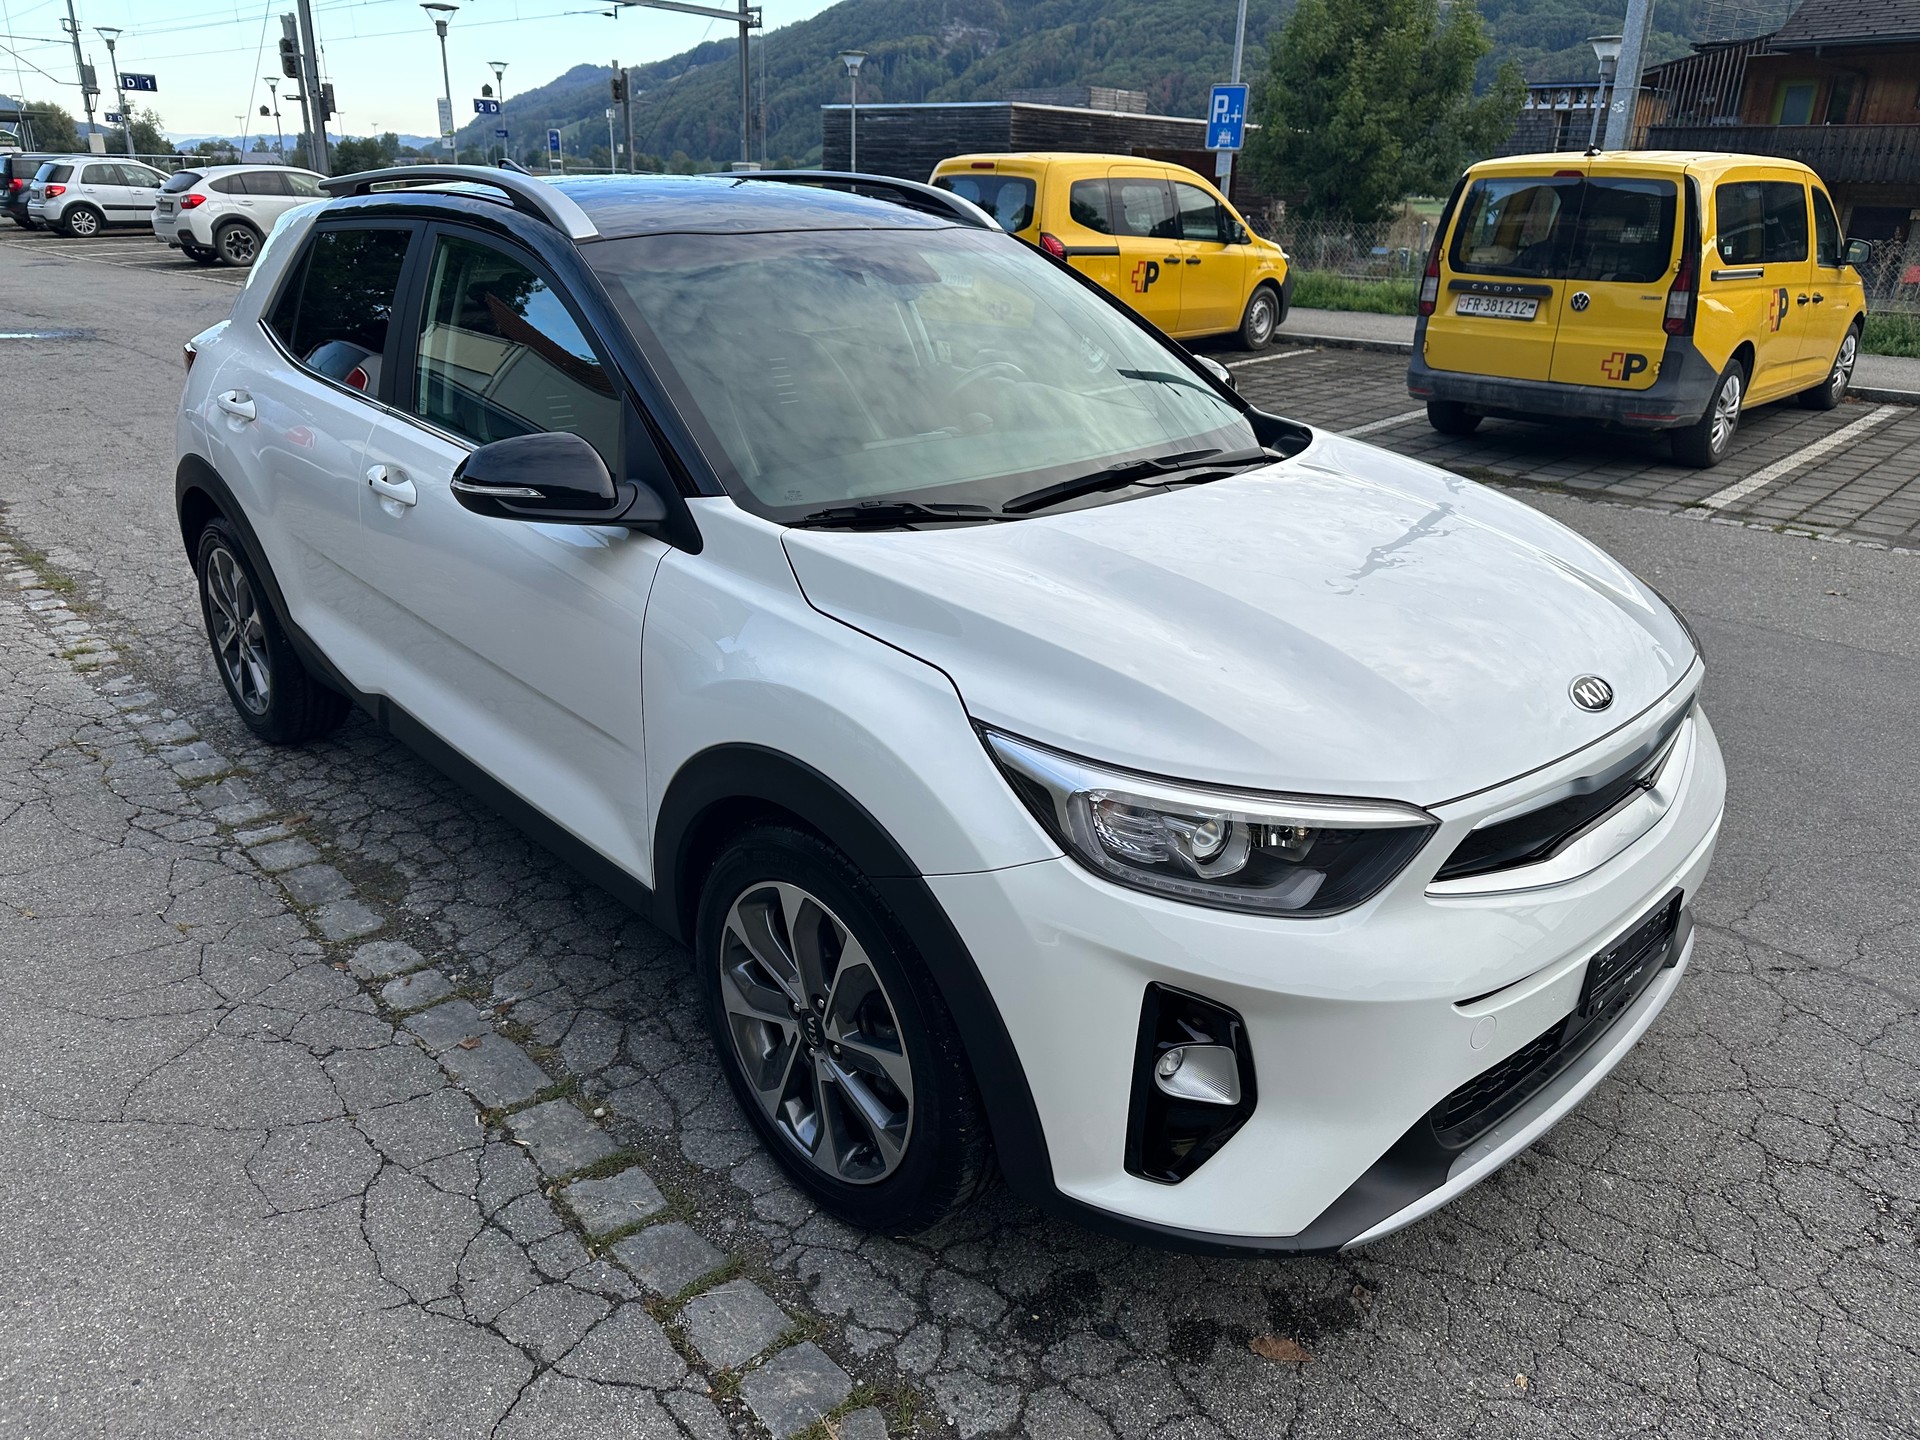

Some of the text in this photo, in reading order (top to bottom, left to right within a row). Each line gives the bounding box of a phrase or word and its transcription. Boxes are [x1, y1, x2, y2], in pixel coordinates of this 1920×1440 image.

[126, 78, 151, 89] D 1
[478, 102, 497, 112] 2 D
[1212, 94, 1230, 123] P
[1471, 283, 1524, 292] CADDY
[1575, 679, 1611, 706] KIA
[807, 1016, 818, 1045] KIA
